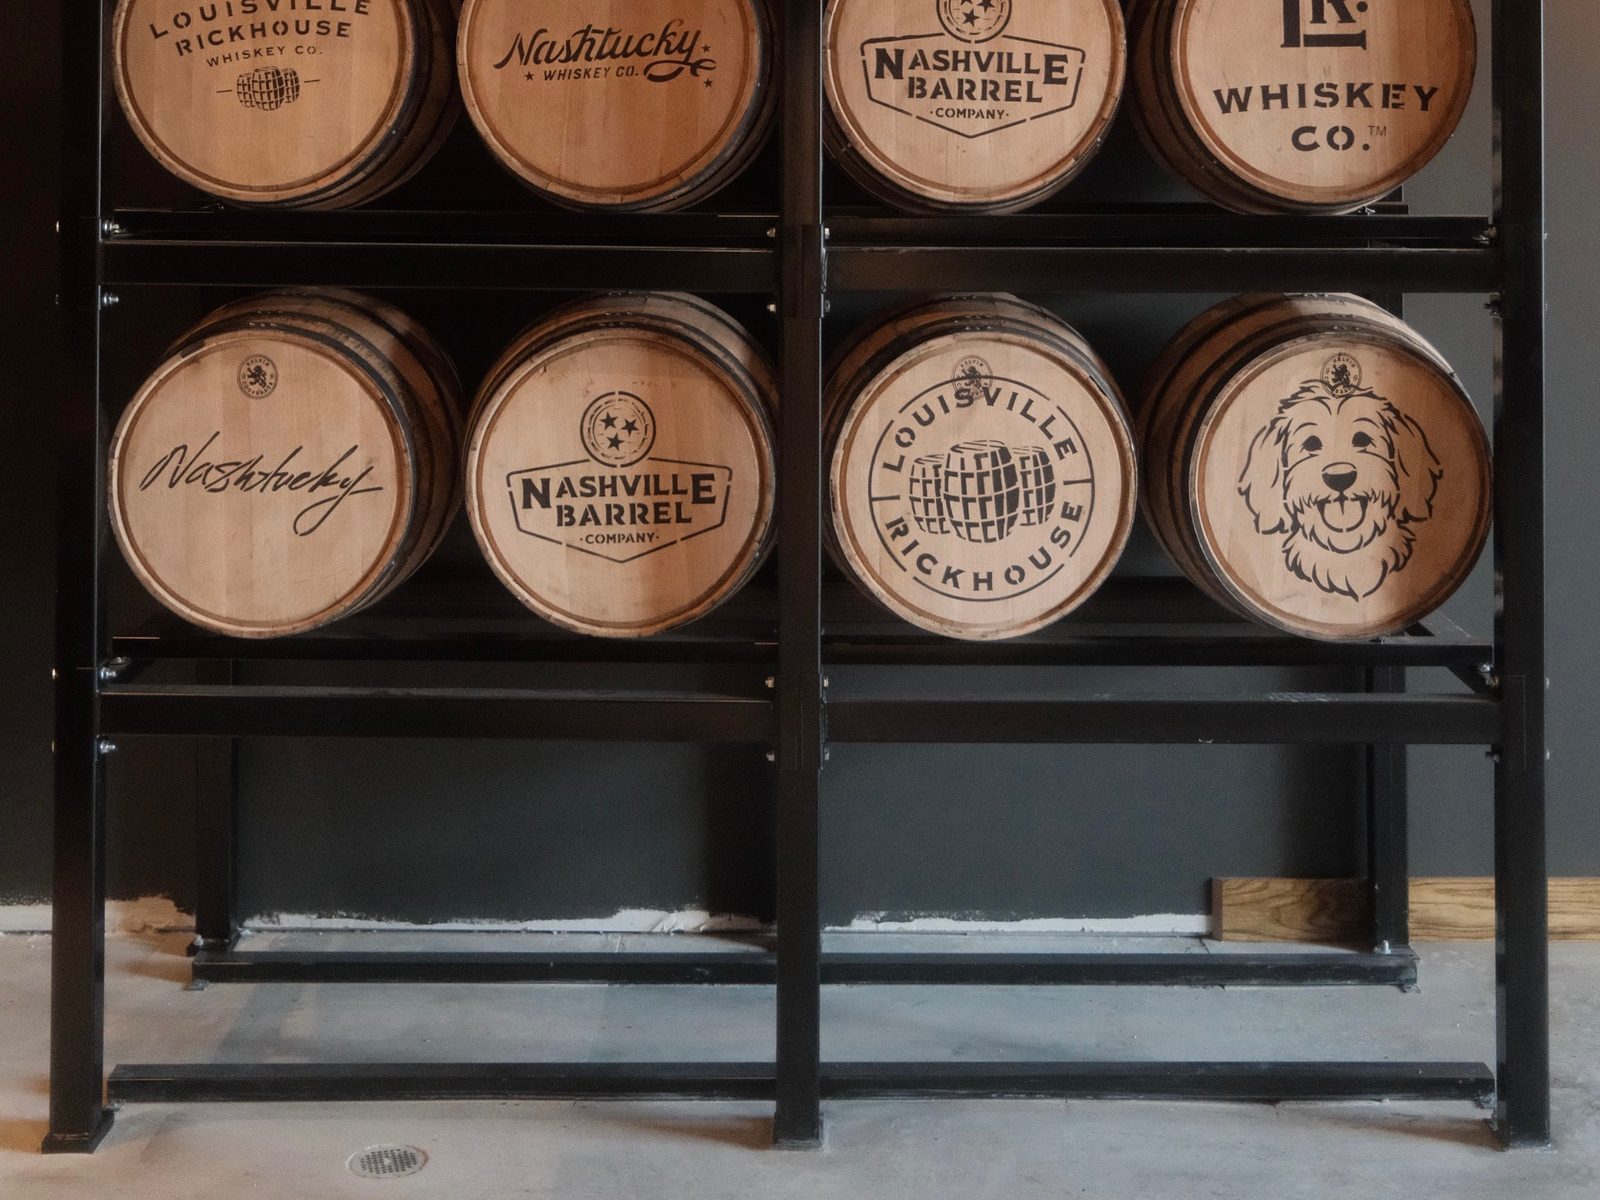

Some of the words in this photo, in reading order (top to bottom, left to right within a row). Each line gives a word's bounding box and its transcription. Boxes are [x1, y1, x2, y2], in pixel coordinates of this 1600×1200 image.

[175, 19, 352, 56] RICKHOUSE
[493, 19, 716, 82] Nashtucky
[206, 46, 285, 67] WHISKEY
[295, 45, 323, 54] CO.
[874, 48, 1068, 85] NASHVILLE
[543, 67, 612, 81] WHISKEY
[616, 66, 639, 77] CO.
[907, 76, 1043, 103] BARREL
[935, 107, 1005, 119] COMPANY
[1212, 82, 1438, 114] WHISKEY
[1291, 125, 1370, 151] CO.
[882, 386, 1077, 473] LOUISVILLE
[139, 431, 383, 537] Nashtucky
[521, 472, 716, 509] NASHVILLE
[556, 501, 692, 527] BARREL
[585, 532, 655, 545] COMPANY
[885, 501, 1083, 591] RICKHOUSE
